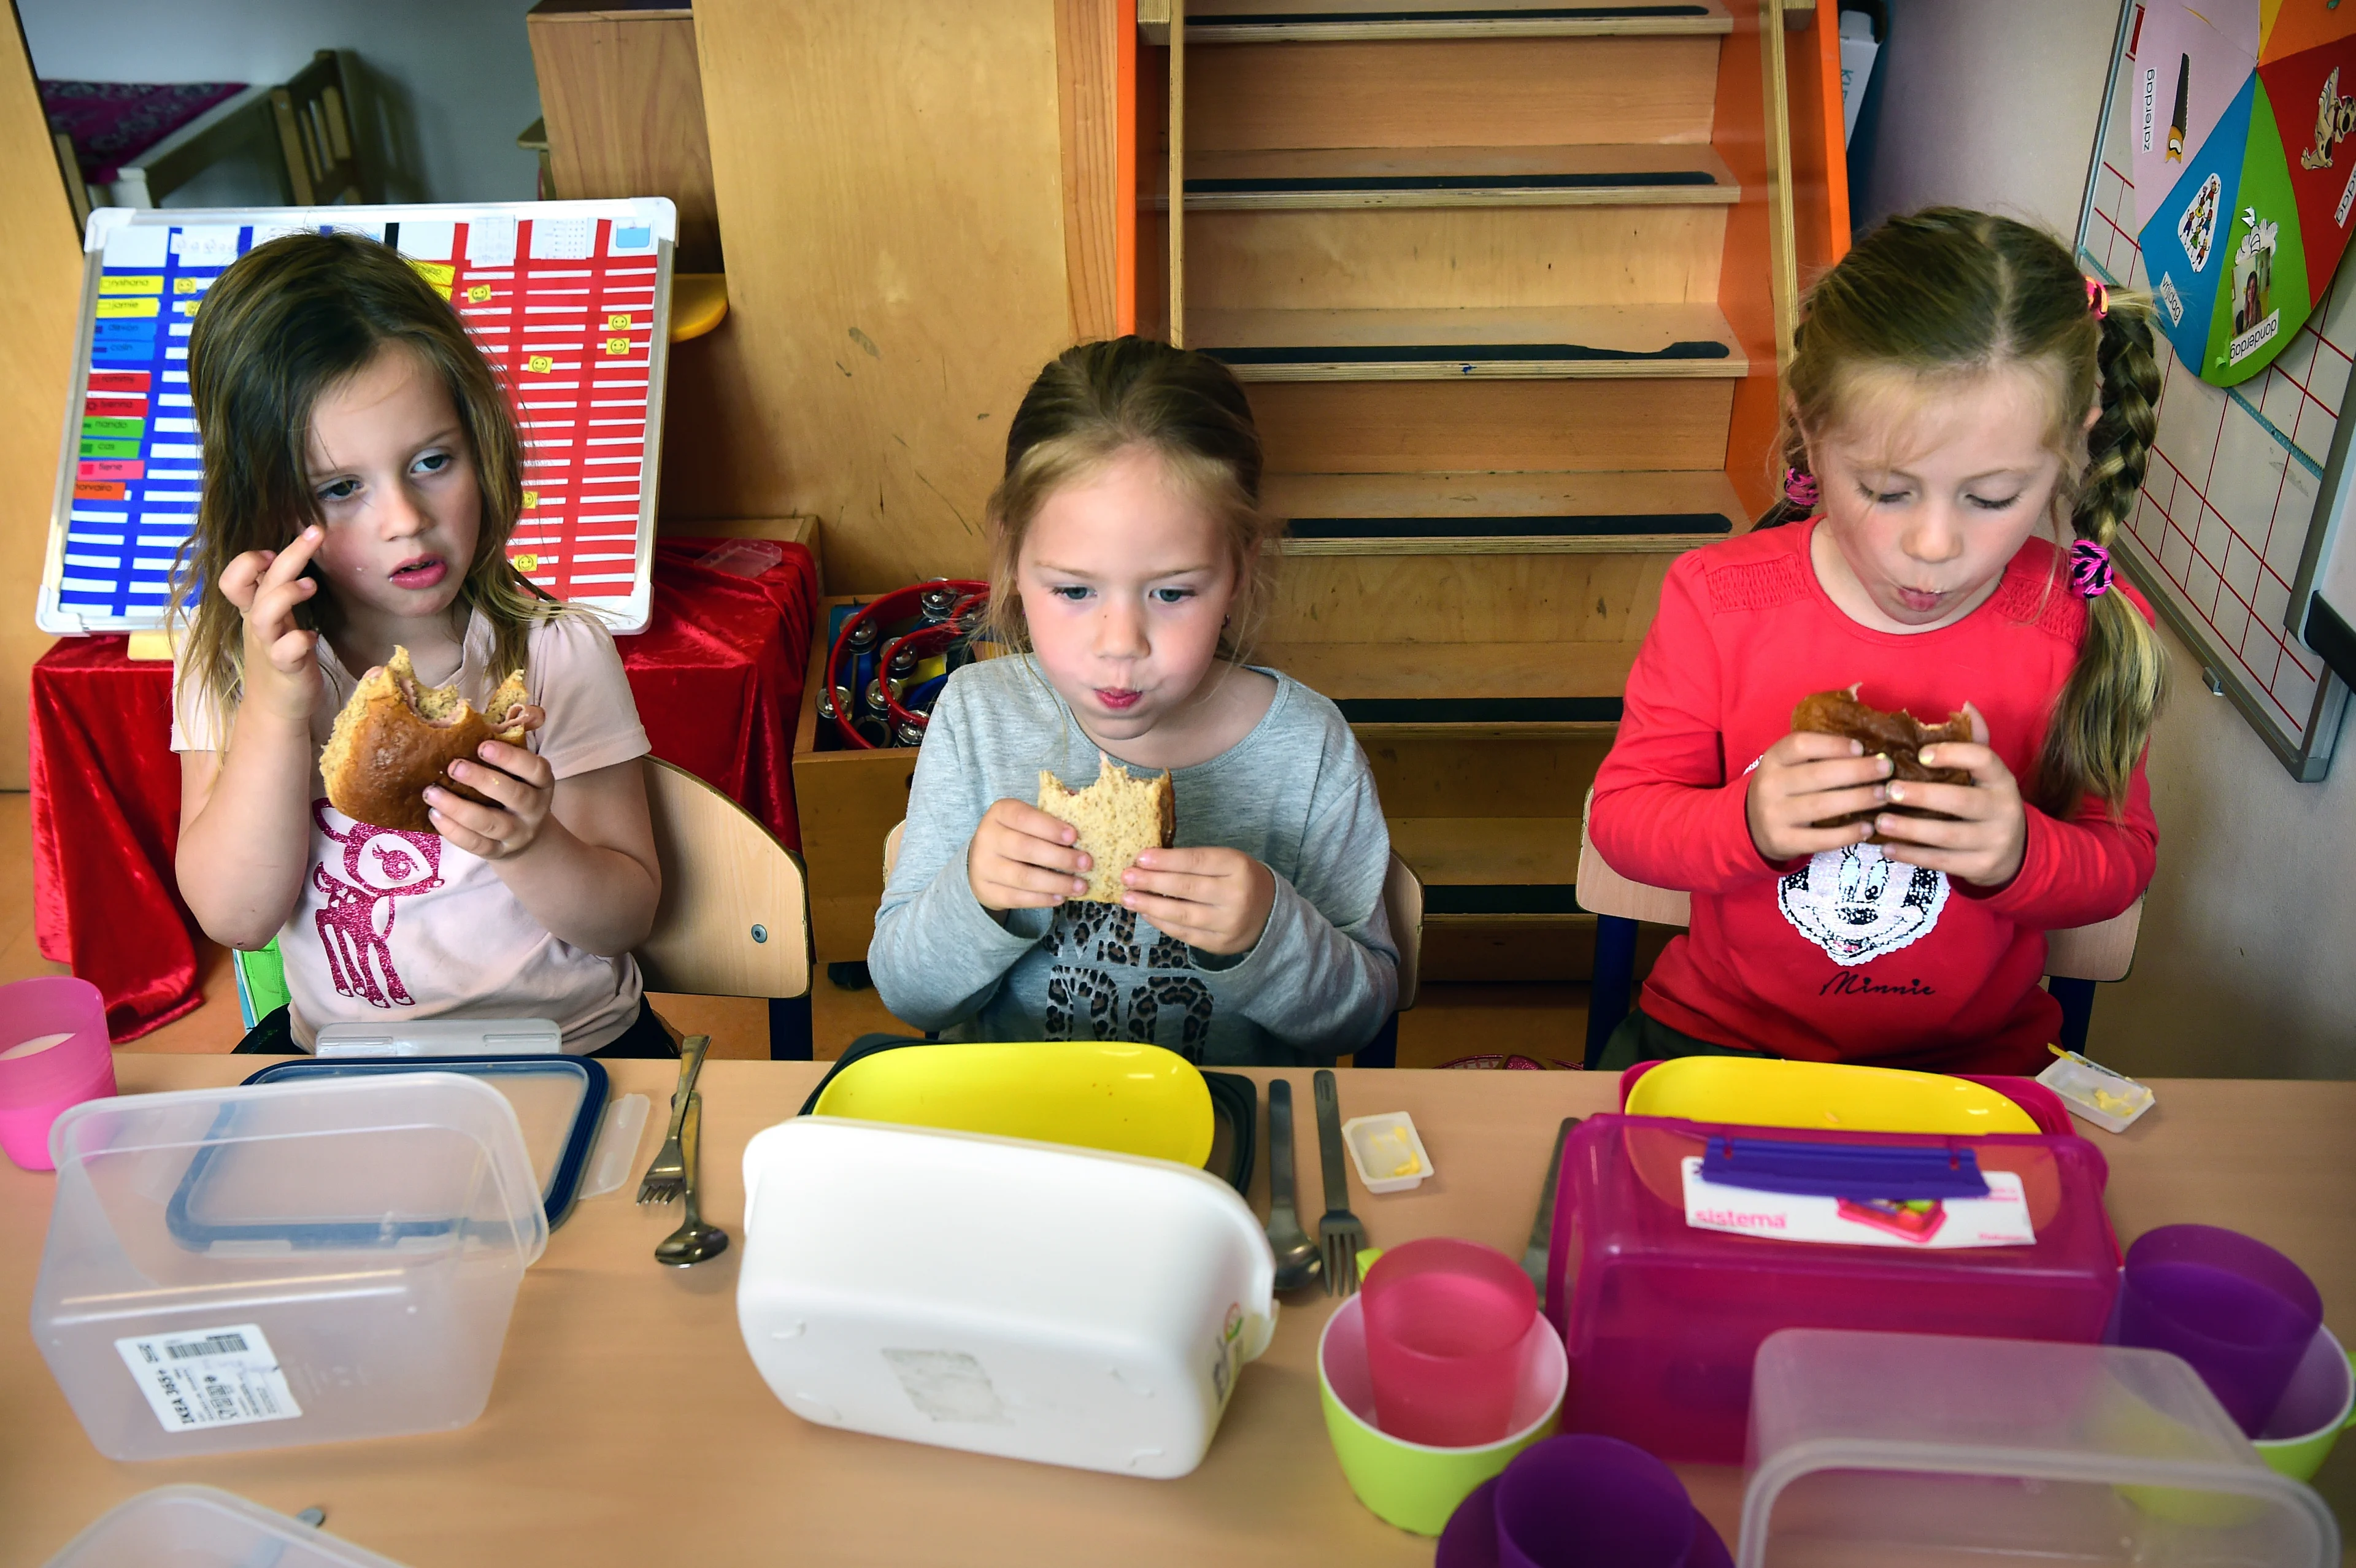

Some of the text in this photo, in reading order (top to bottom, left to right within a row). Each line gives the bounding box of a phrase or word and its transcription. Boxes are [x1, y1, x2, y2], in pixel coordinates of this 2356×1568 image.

[2143, 69, 2155, 152] zaterdag
[2162, 277, 2181, 321] vrijdag
[2230, 318, 2277, 359] donderdag
[1819, 970, 1936, 996] Minnie
[1695, 1208, 1787, 1230] sistema
[172, 1398, 194, 1424] IKEA
